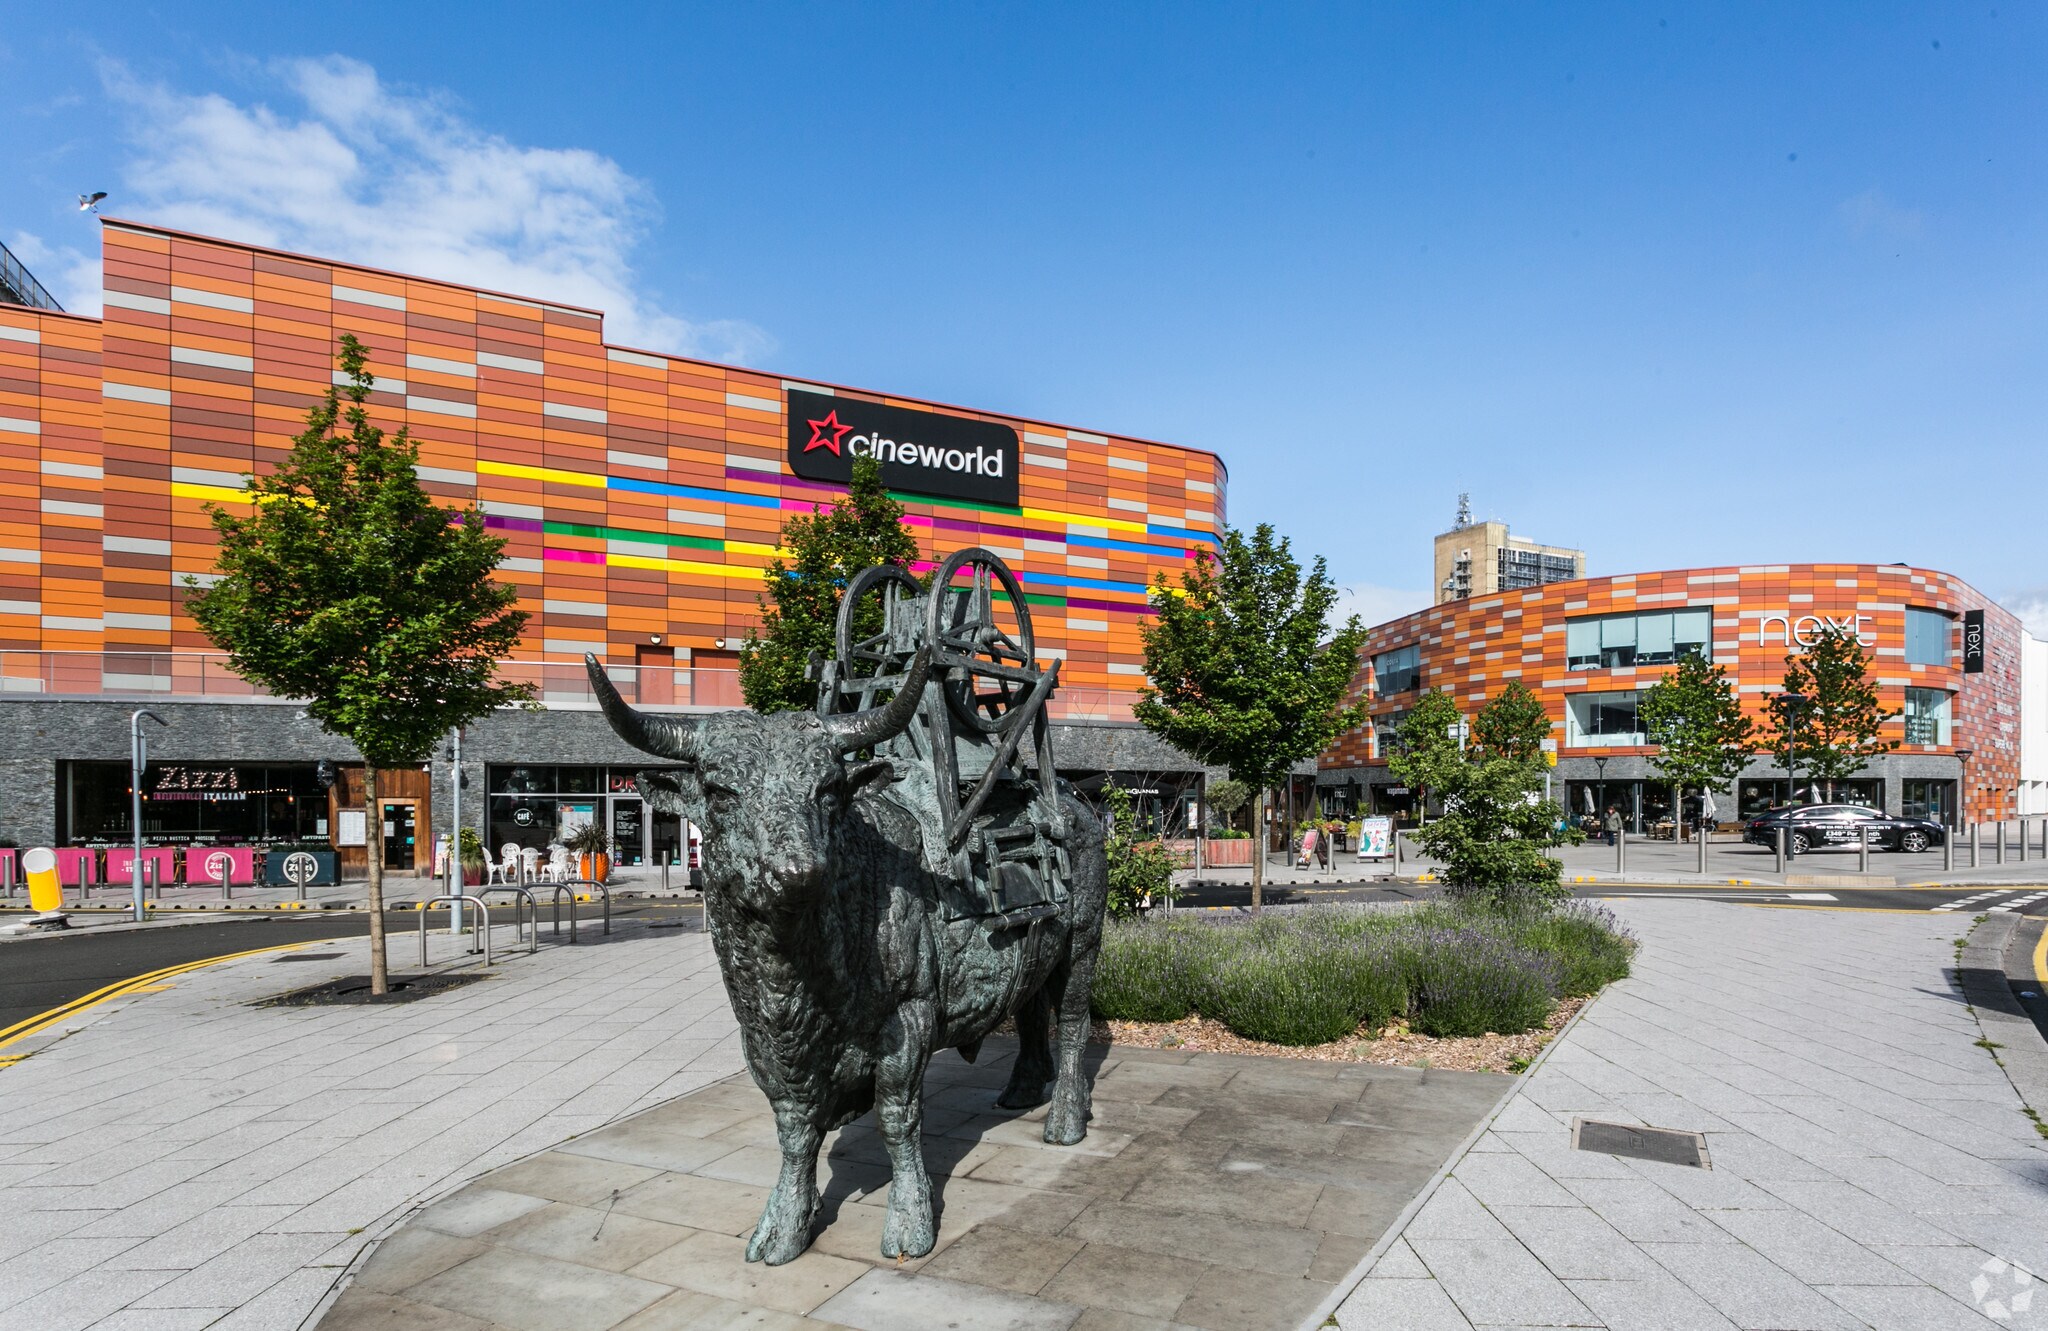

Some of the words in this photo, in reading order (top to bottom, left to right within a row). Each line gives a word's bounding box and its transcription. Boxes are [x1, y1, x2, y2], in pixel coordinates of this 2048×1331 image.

[847, 432, 1003, 478] cineworld
[1760, 613, 1874, 648] next
[1967, 623, 1981, 659] next
[156, 766, 238, 790] Zizzi
[203, 792, 246, 800] ITALIAN
